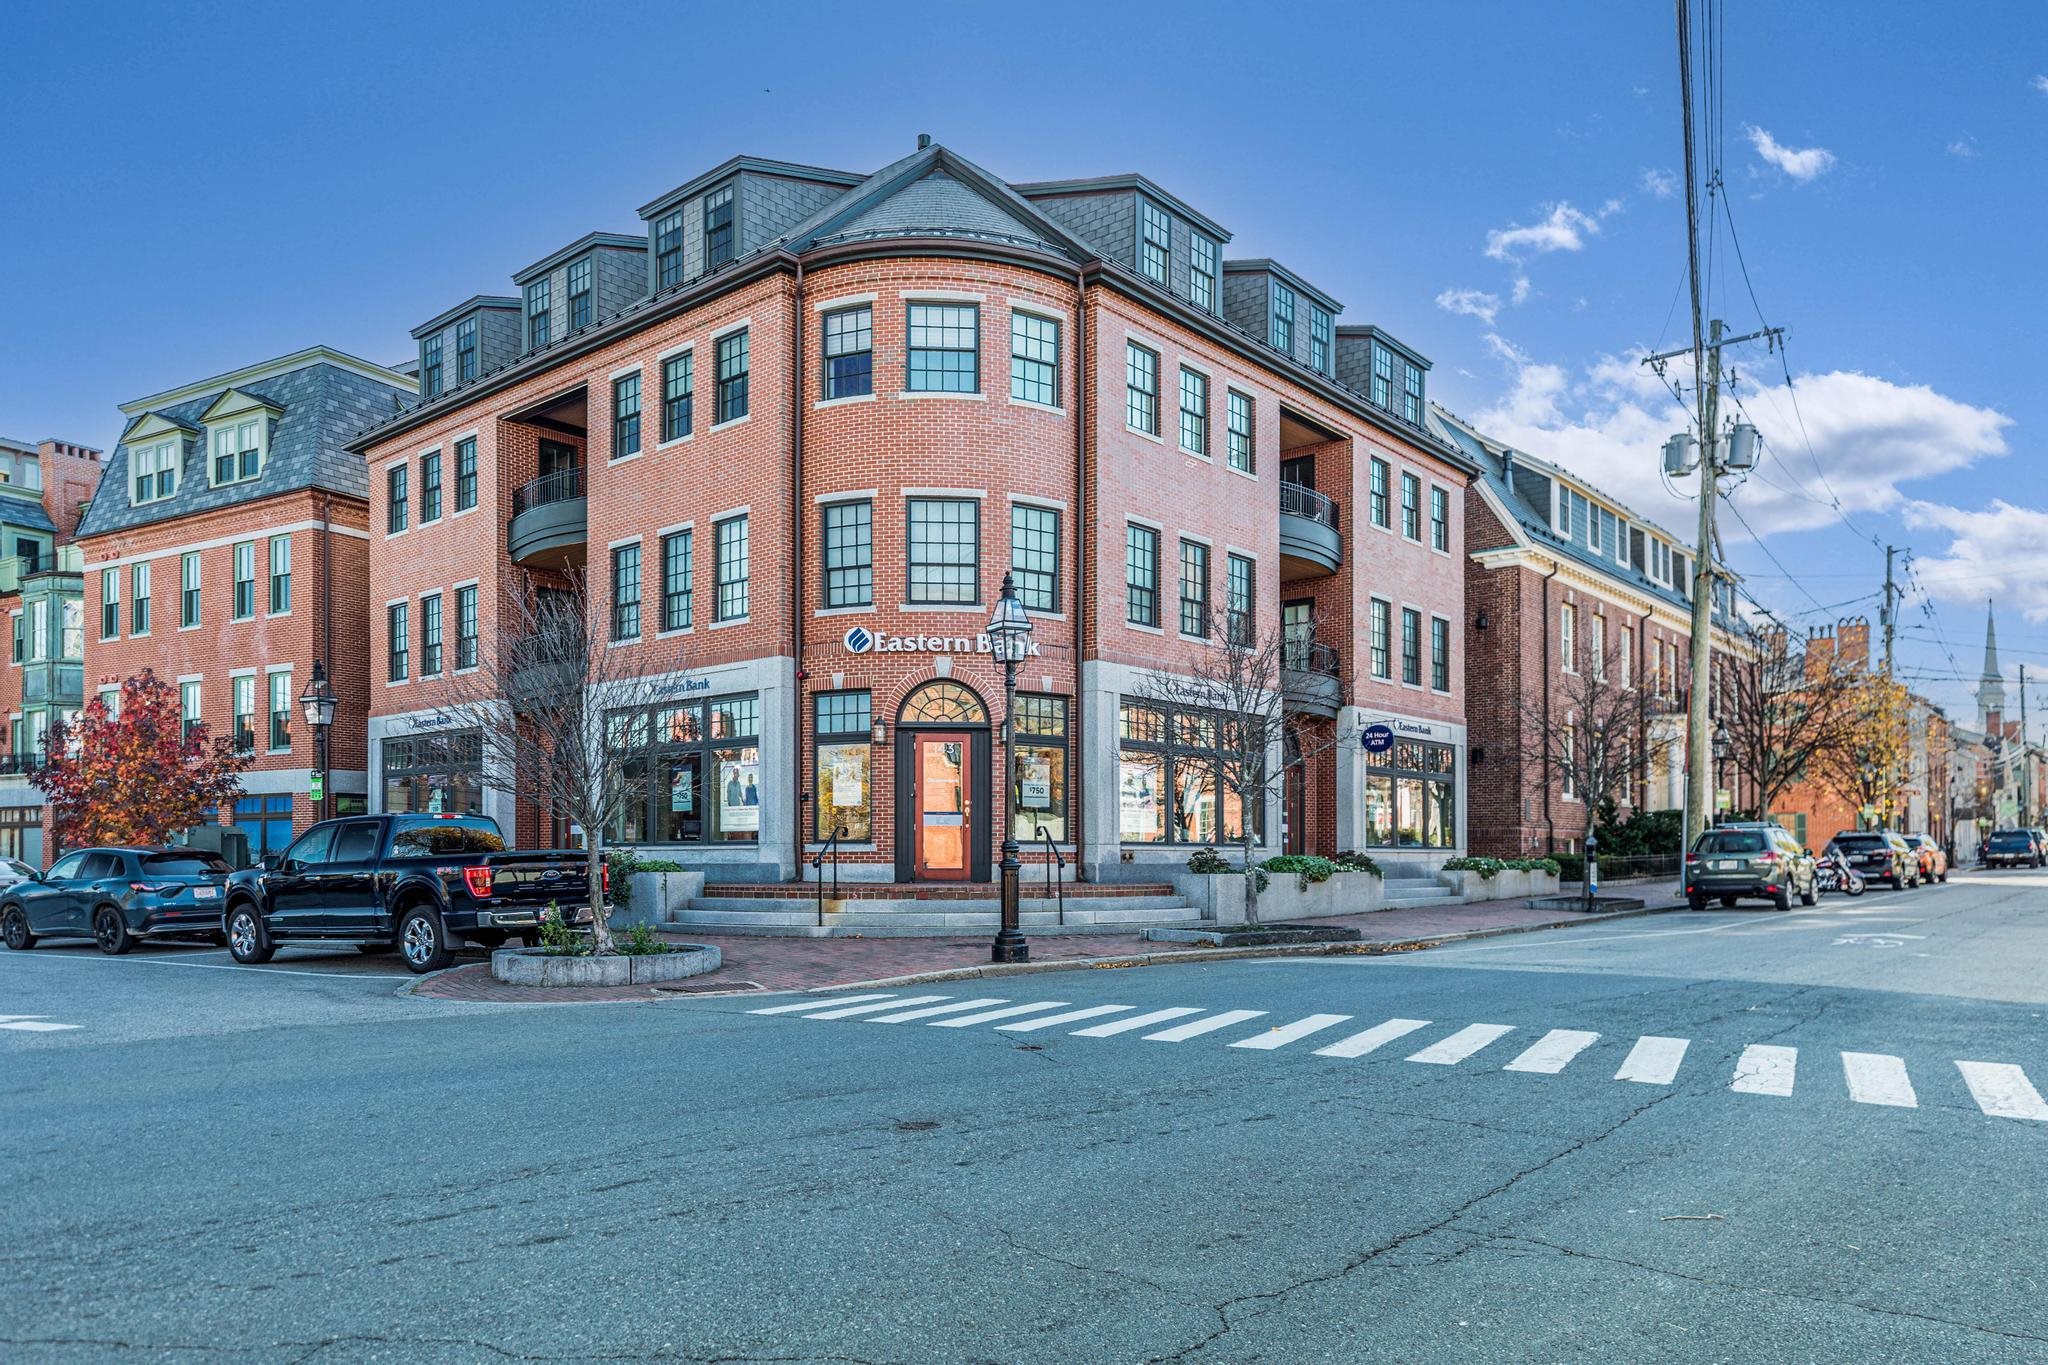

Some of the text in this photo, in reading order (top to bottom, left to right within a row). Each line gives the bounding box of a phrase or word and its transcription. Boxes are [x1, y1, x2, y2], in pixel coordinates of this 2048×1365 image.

[874, 632, 971, 653] Eastern
[685, 677, 710, 692] Bank
[1373, 731, 1389, 739] Hour
[1399, 721, 1432, 736] Eastern Bank
[1029, 786, 1045, 795] $750
